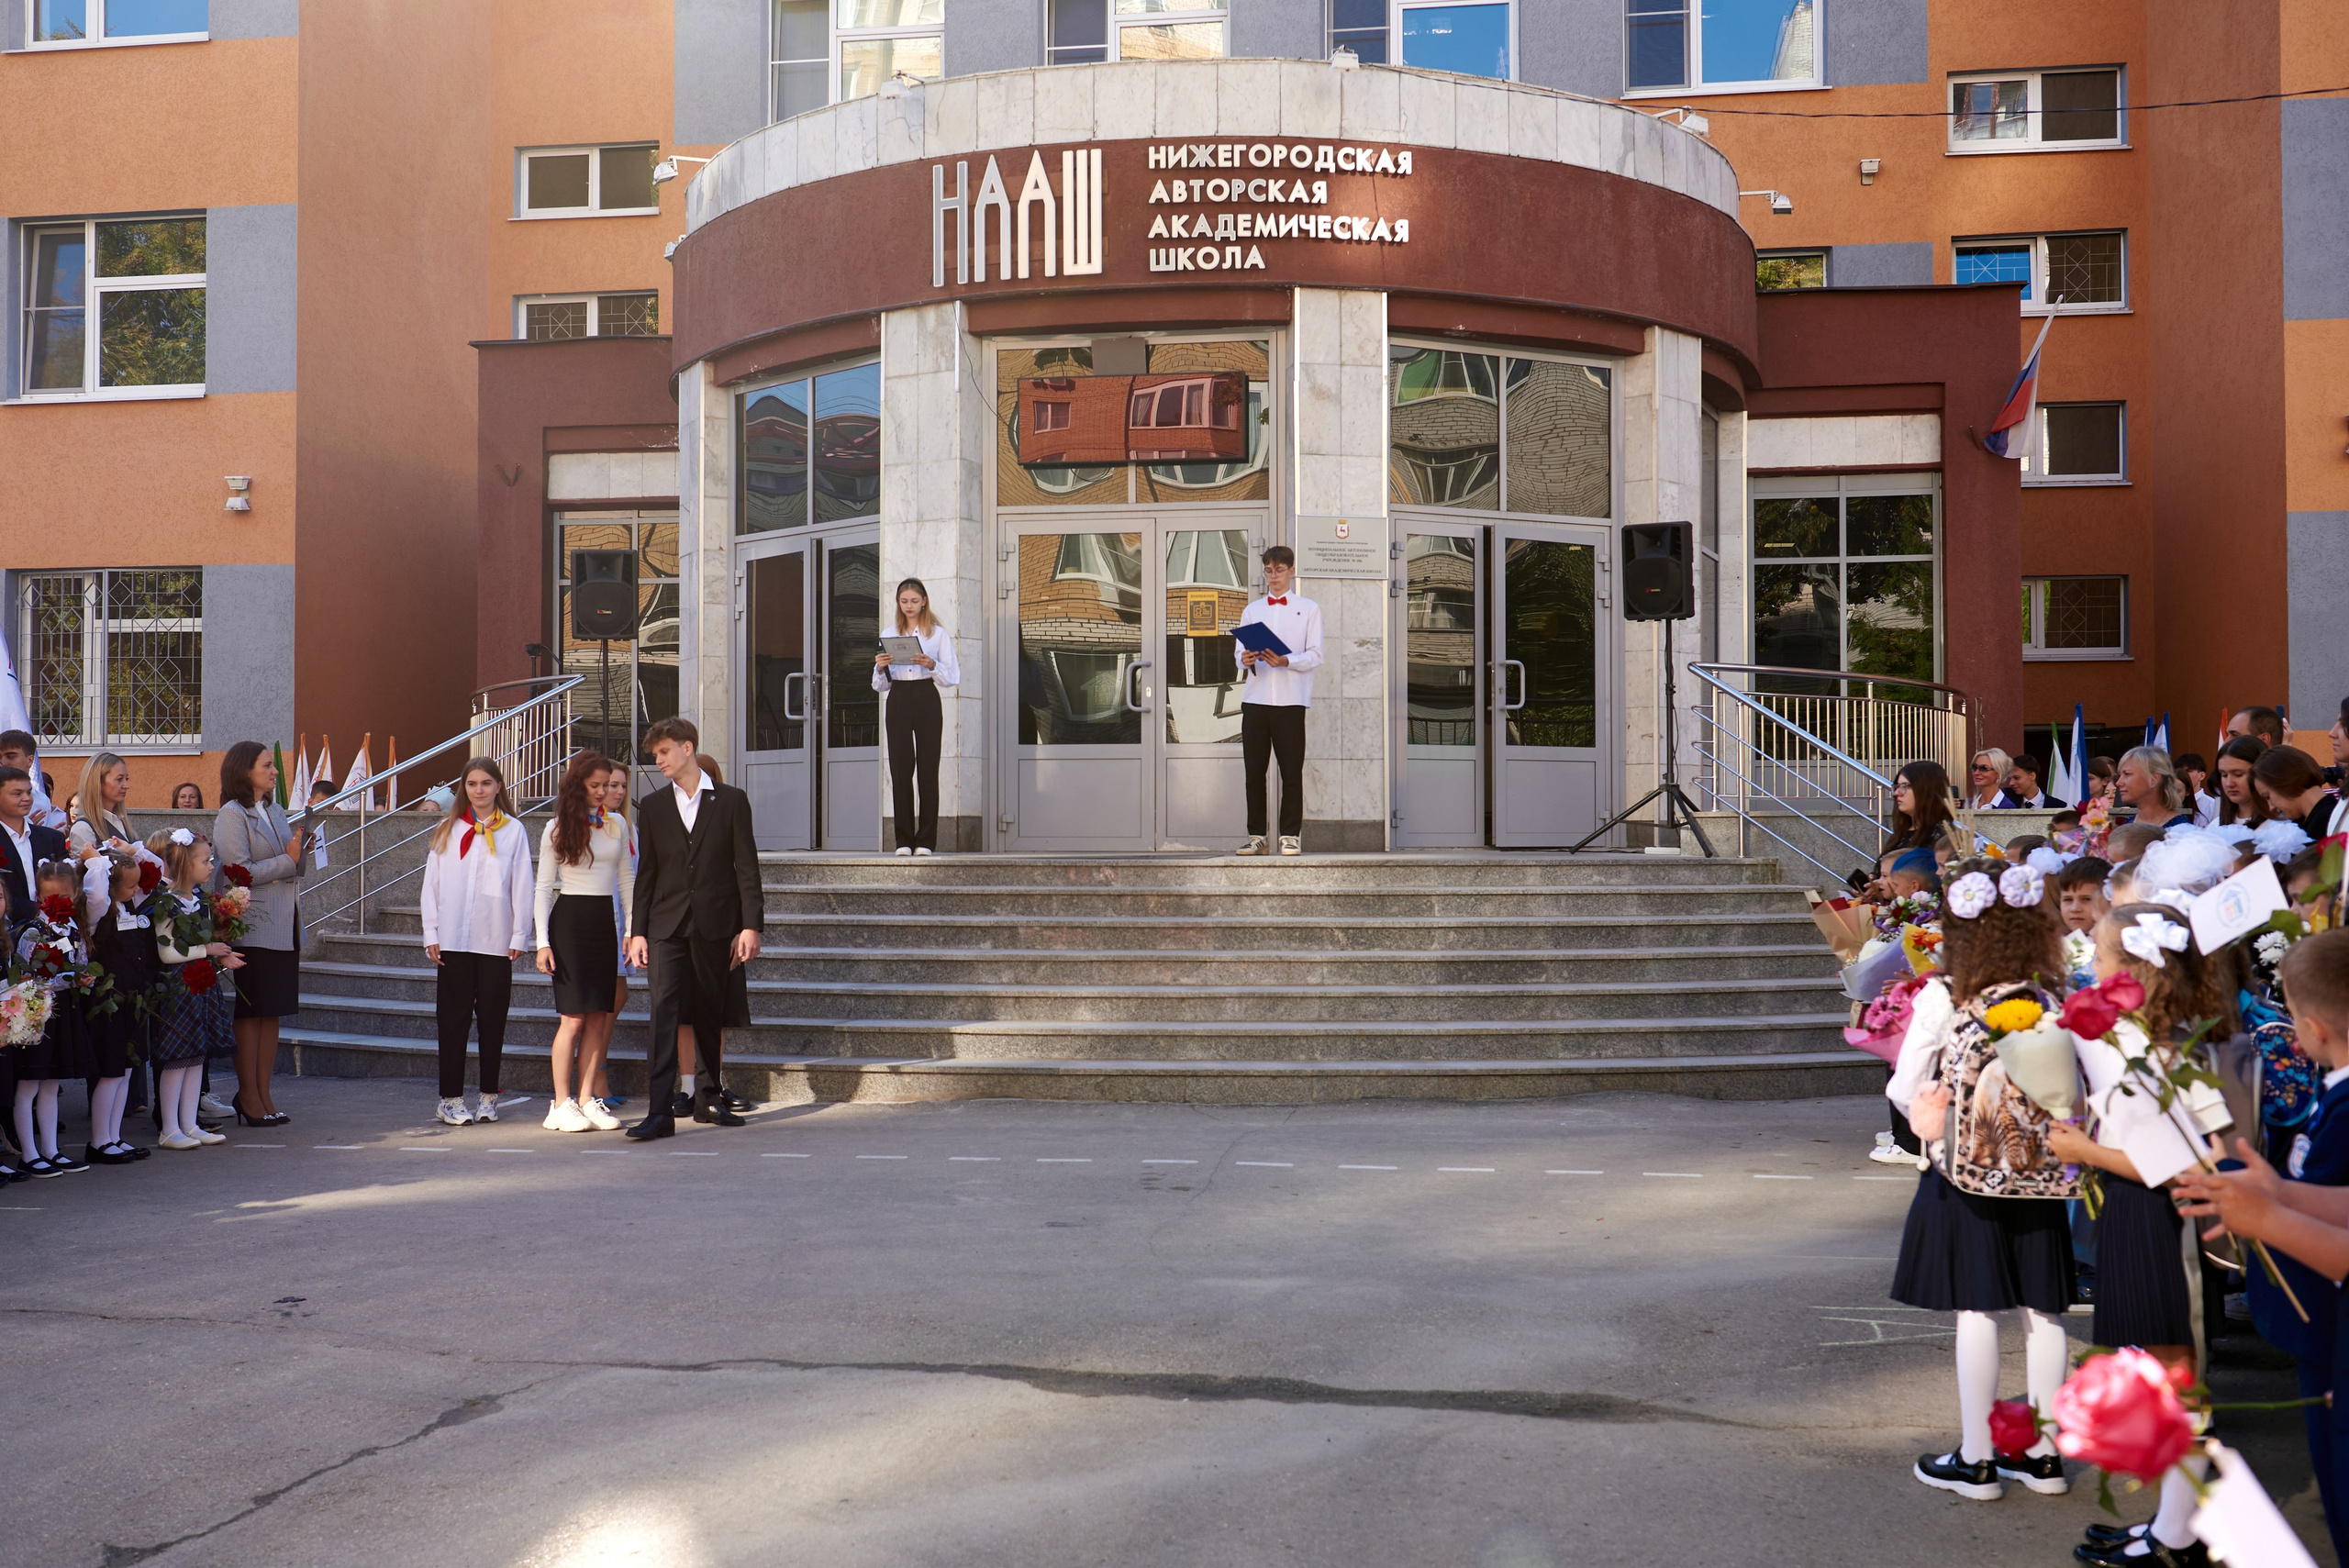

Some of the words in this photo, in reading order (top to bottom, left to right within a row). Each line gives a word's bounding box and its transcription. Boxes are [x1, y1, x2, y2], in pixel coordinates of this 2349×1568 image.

[1148, 143, 1413, 175] НИЖЕГОРОДСКАЯ
[1148, 178, 1328, 205] АВТОРСКАЯ
[1148, 213, 1409, 243] АКАДЕМИЧЕСКАЯ
[1149, 245, 1266, 272] ШКОЛА
